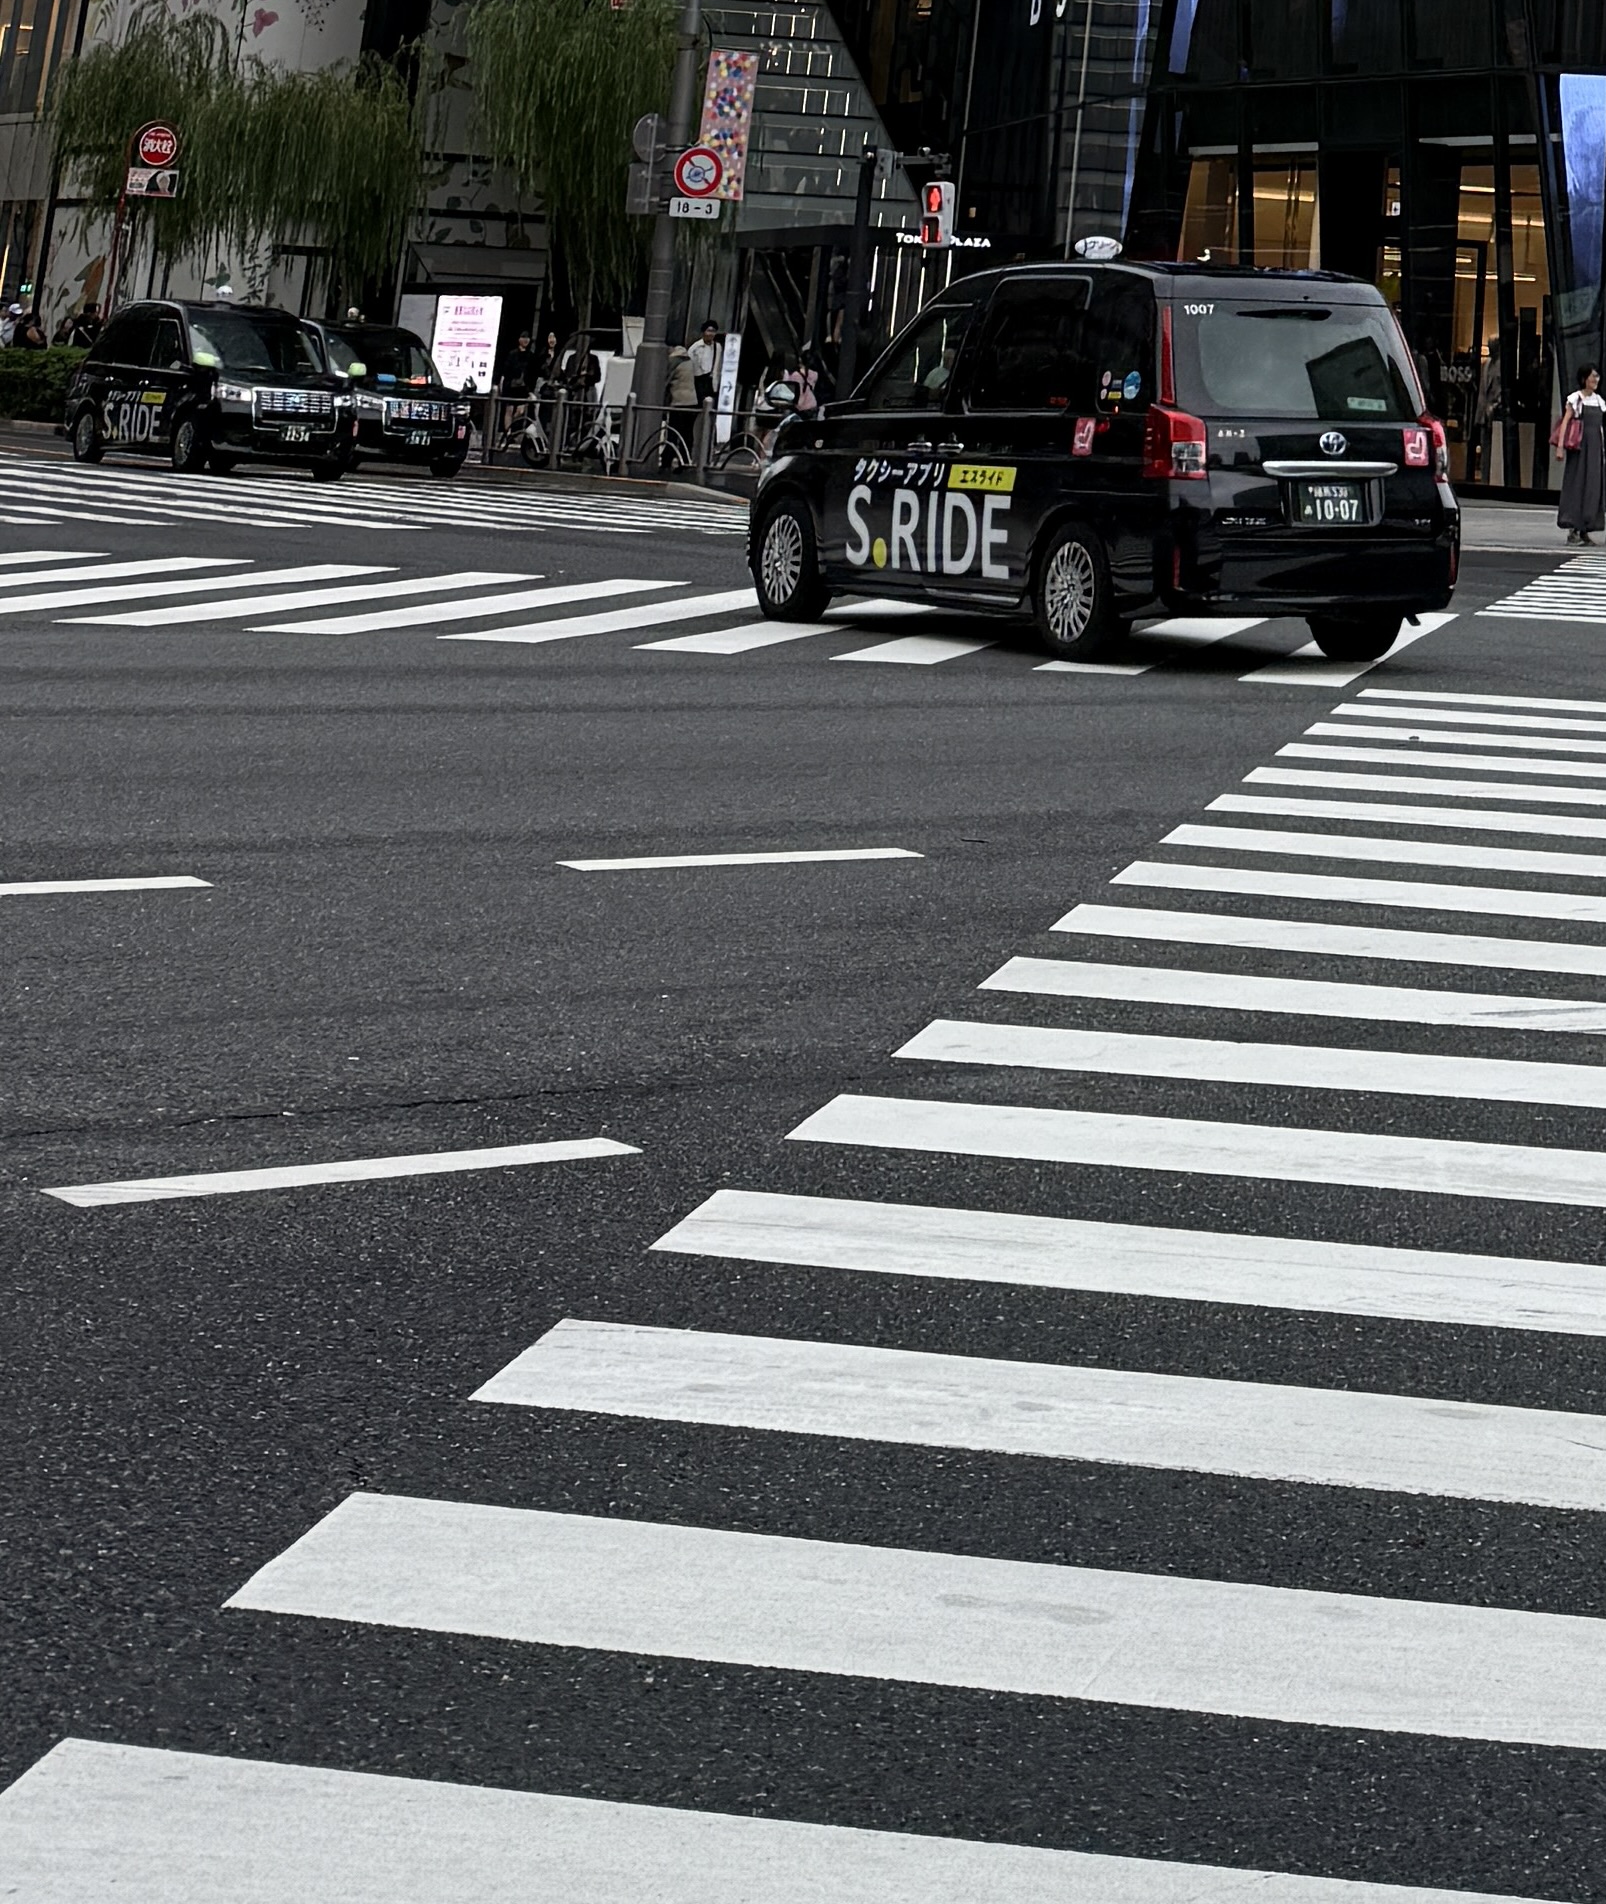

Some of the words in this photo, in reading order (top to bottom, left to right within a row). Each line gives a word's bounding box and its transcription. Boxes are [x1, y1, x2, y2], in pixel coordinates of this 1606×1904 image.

[896, 232, 923, 245] TOK
[1183, 303, 1215, 316] 1007
[102, 401, 163, 442] S.RIDE
[853, 457, 946, 488] タクシーアプリ
[959, 469, 1003, 486] エスライド
[845, 484, 1012, 580] S.RIDE
